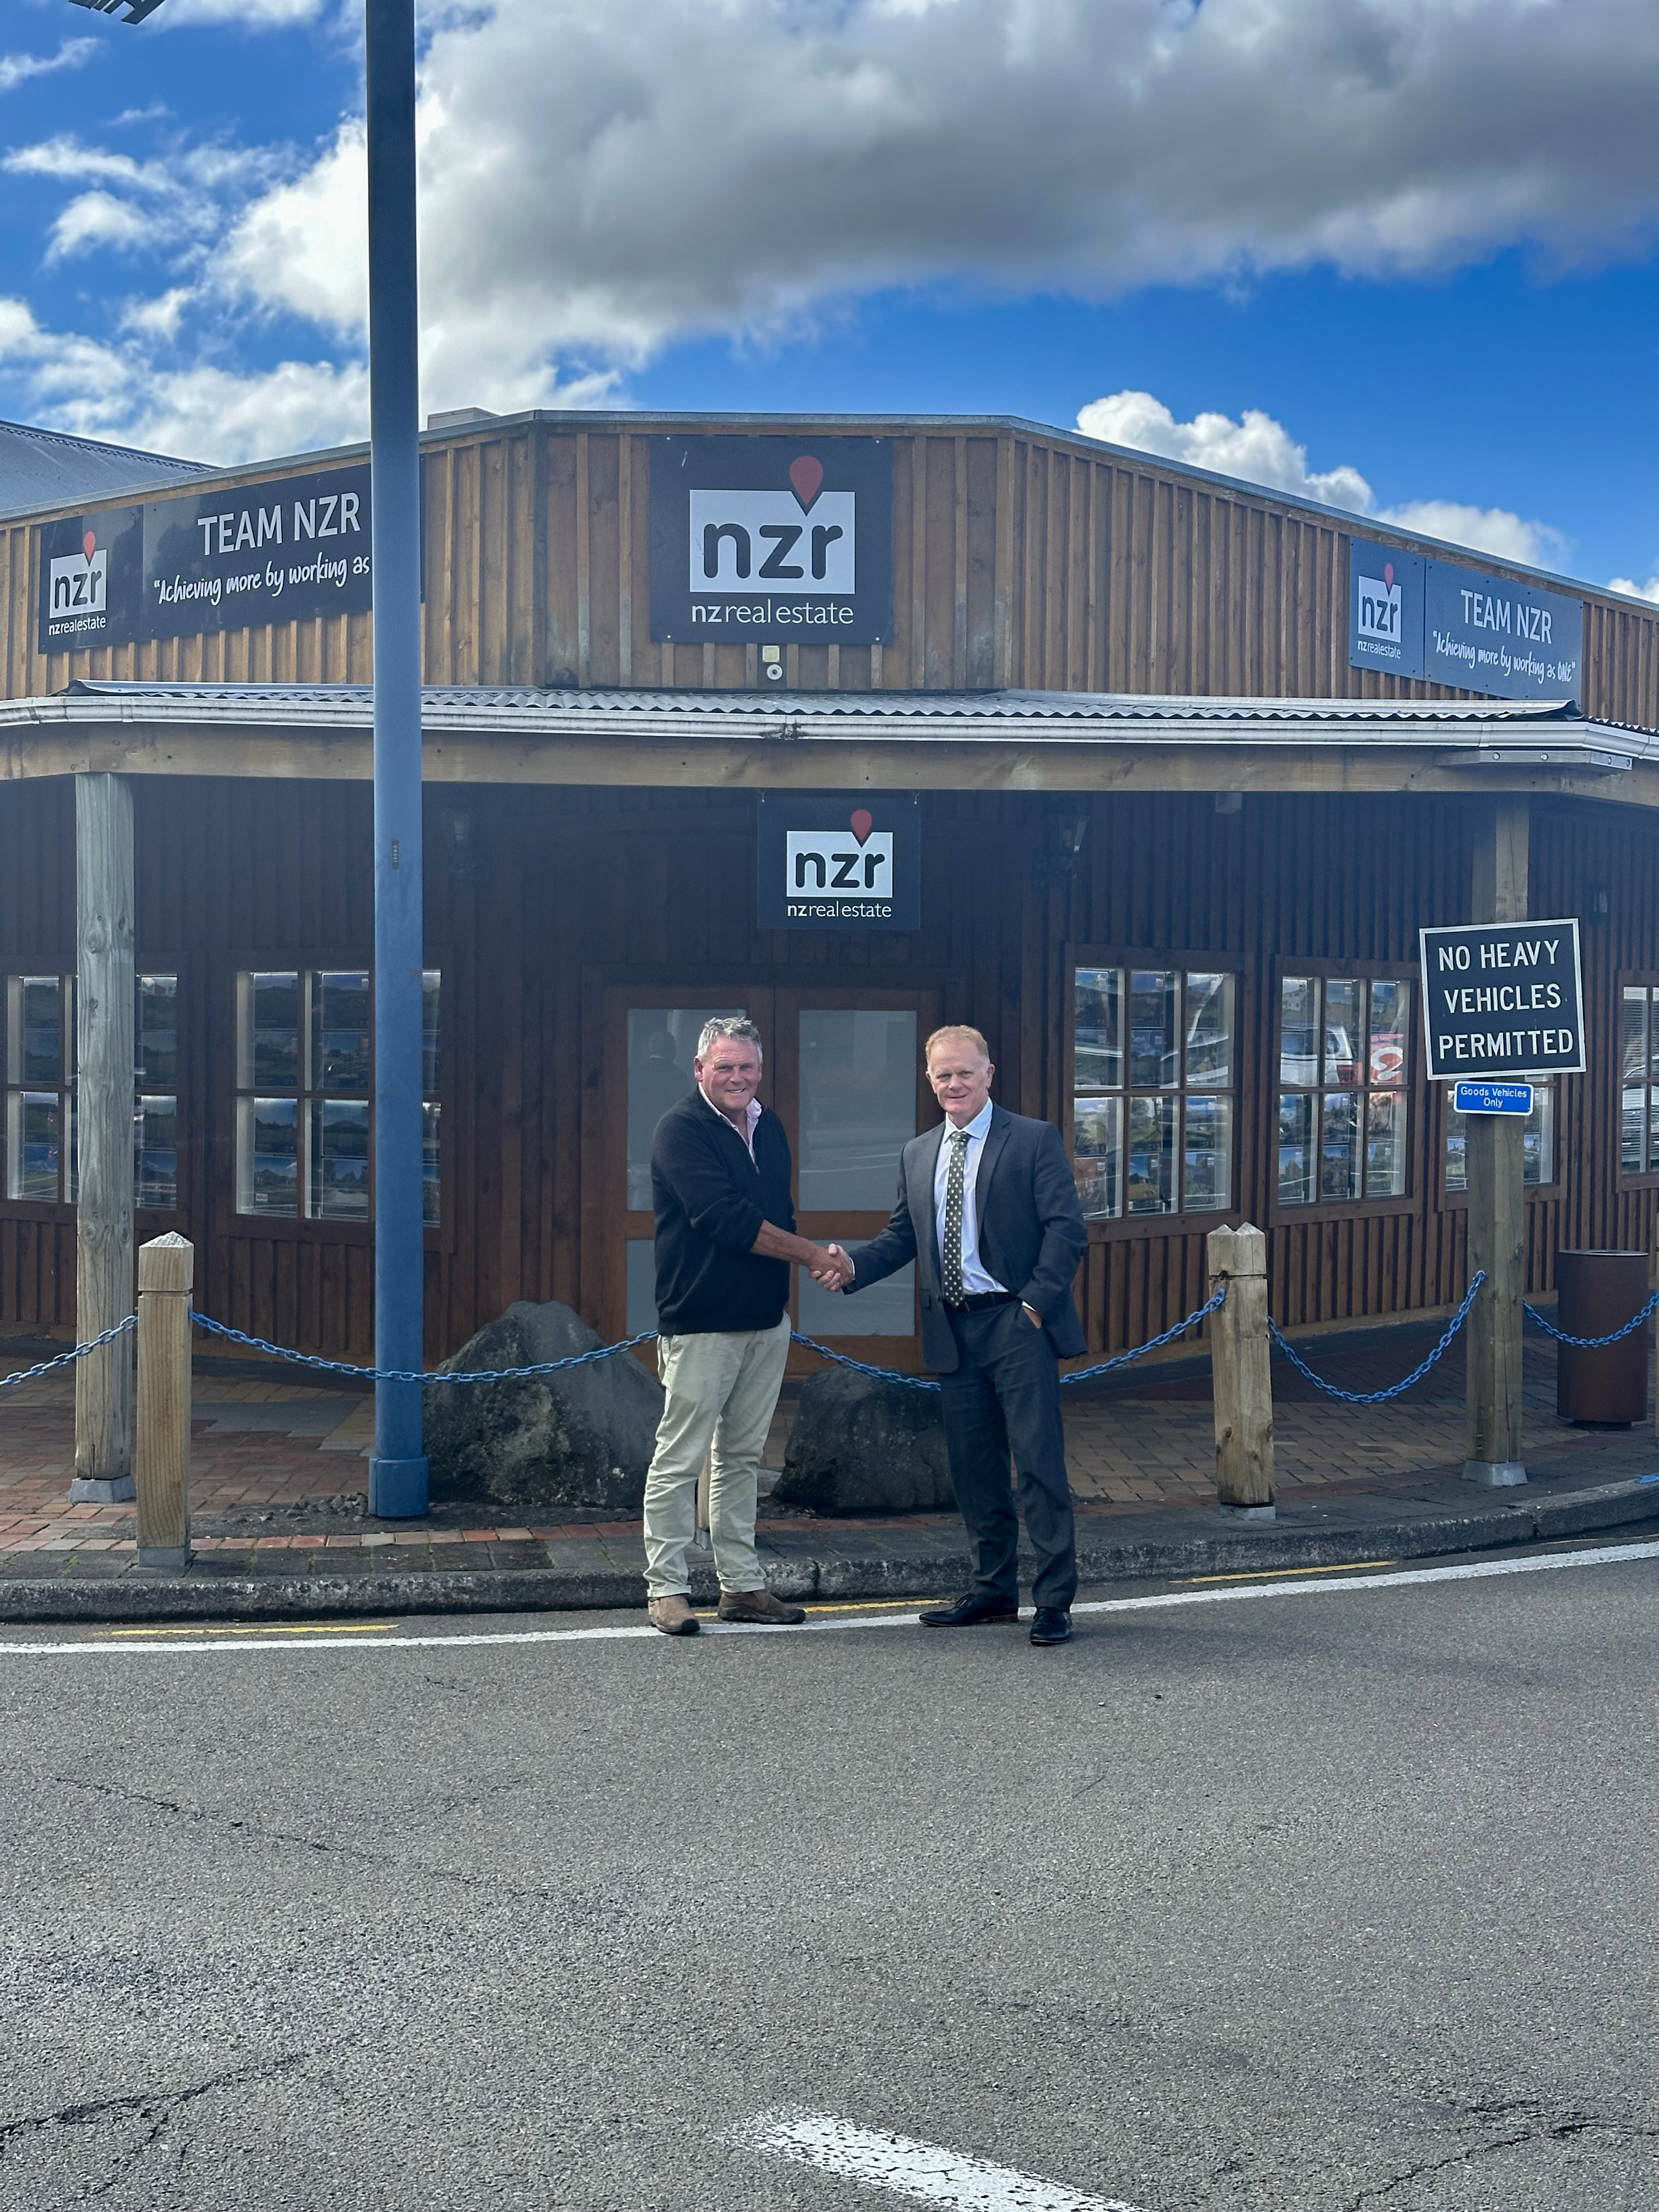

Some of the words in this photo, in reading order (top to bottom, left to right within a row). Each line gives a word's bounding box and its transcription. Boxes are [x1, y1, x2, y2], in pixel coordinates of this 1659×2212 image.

[197, 504, 283, 556] TEAM
[294, 492, 361, 541] NZR
[703, 523, 844, 580] nzr
[54, 570, 102, 609] nzr
[226, 573, 262, 594] more
[265, 560, 284, 597] by
[289, 552, 348, 588] working
[352, 556, 371, 575] as
[1362, 595, 1398, 634] nzr
[1460, 589, 1511, 634] TEAM
[1517, 604, 1552, 644] NZR
[1478, 649, 1499, 665] more
[1500, 645, 1512, 676] by
[1513, 651, 1544, 684] working
[1547, 663, 1556, 680] as
[795, 852, 886, 888] nzr
[1438, 945, 1471, 971] NO
[1480, 939, 1559, 968] HEAVY
[1443, 983, 1561, 1014] VEHICLES
[1439, 1029, 1574, 1059] PERMITTED
[1460, 1086, 1490, 1097] Goods
[1492, 1087, 1528, 1098] Vehicles
[1483, 1097, 1503, 1108] Only
